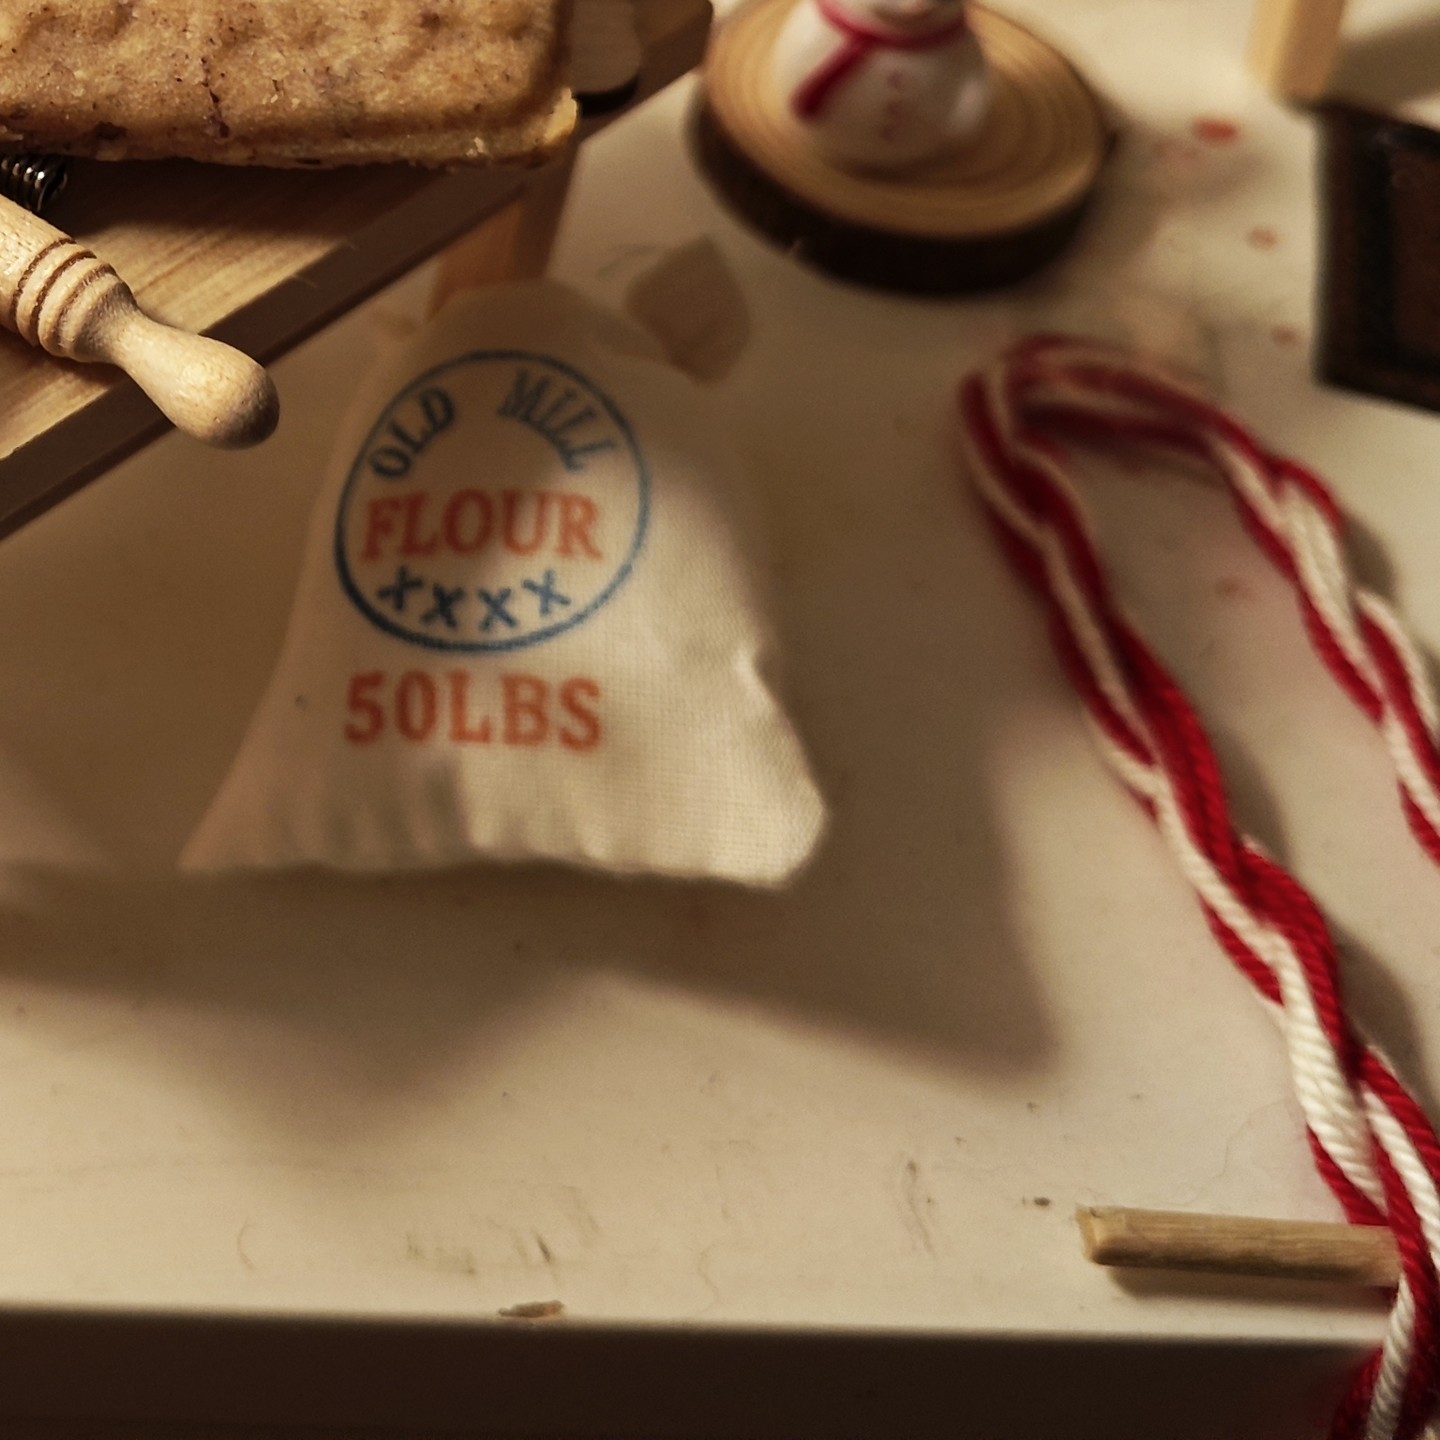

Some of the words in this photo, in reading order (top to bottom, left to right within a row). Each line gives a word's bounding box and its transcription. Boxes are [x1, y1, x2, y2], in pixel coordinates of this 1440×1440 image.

[368, 386, 455, 479] OLD
[497, 368, 617, 472] MILL
[362, 488, 604, 561] FLOUR
[344, 668, 605, 753] 50LBS
